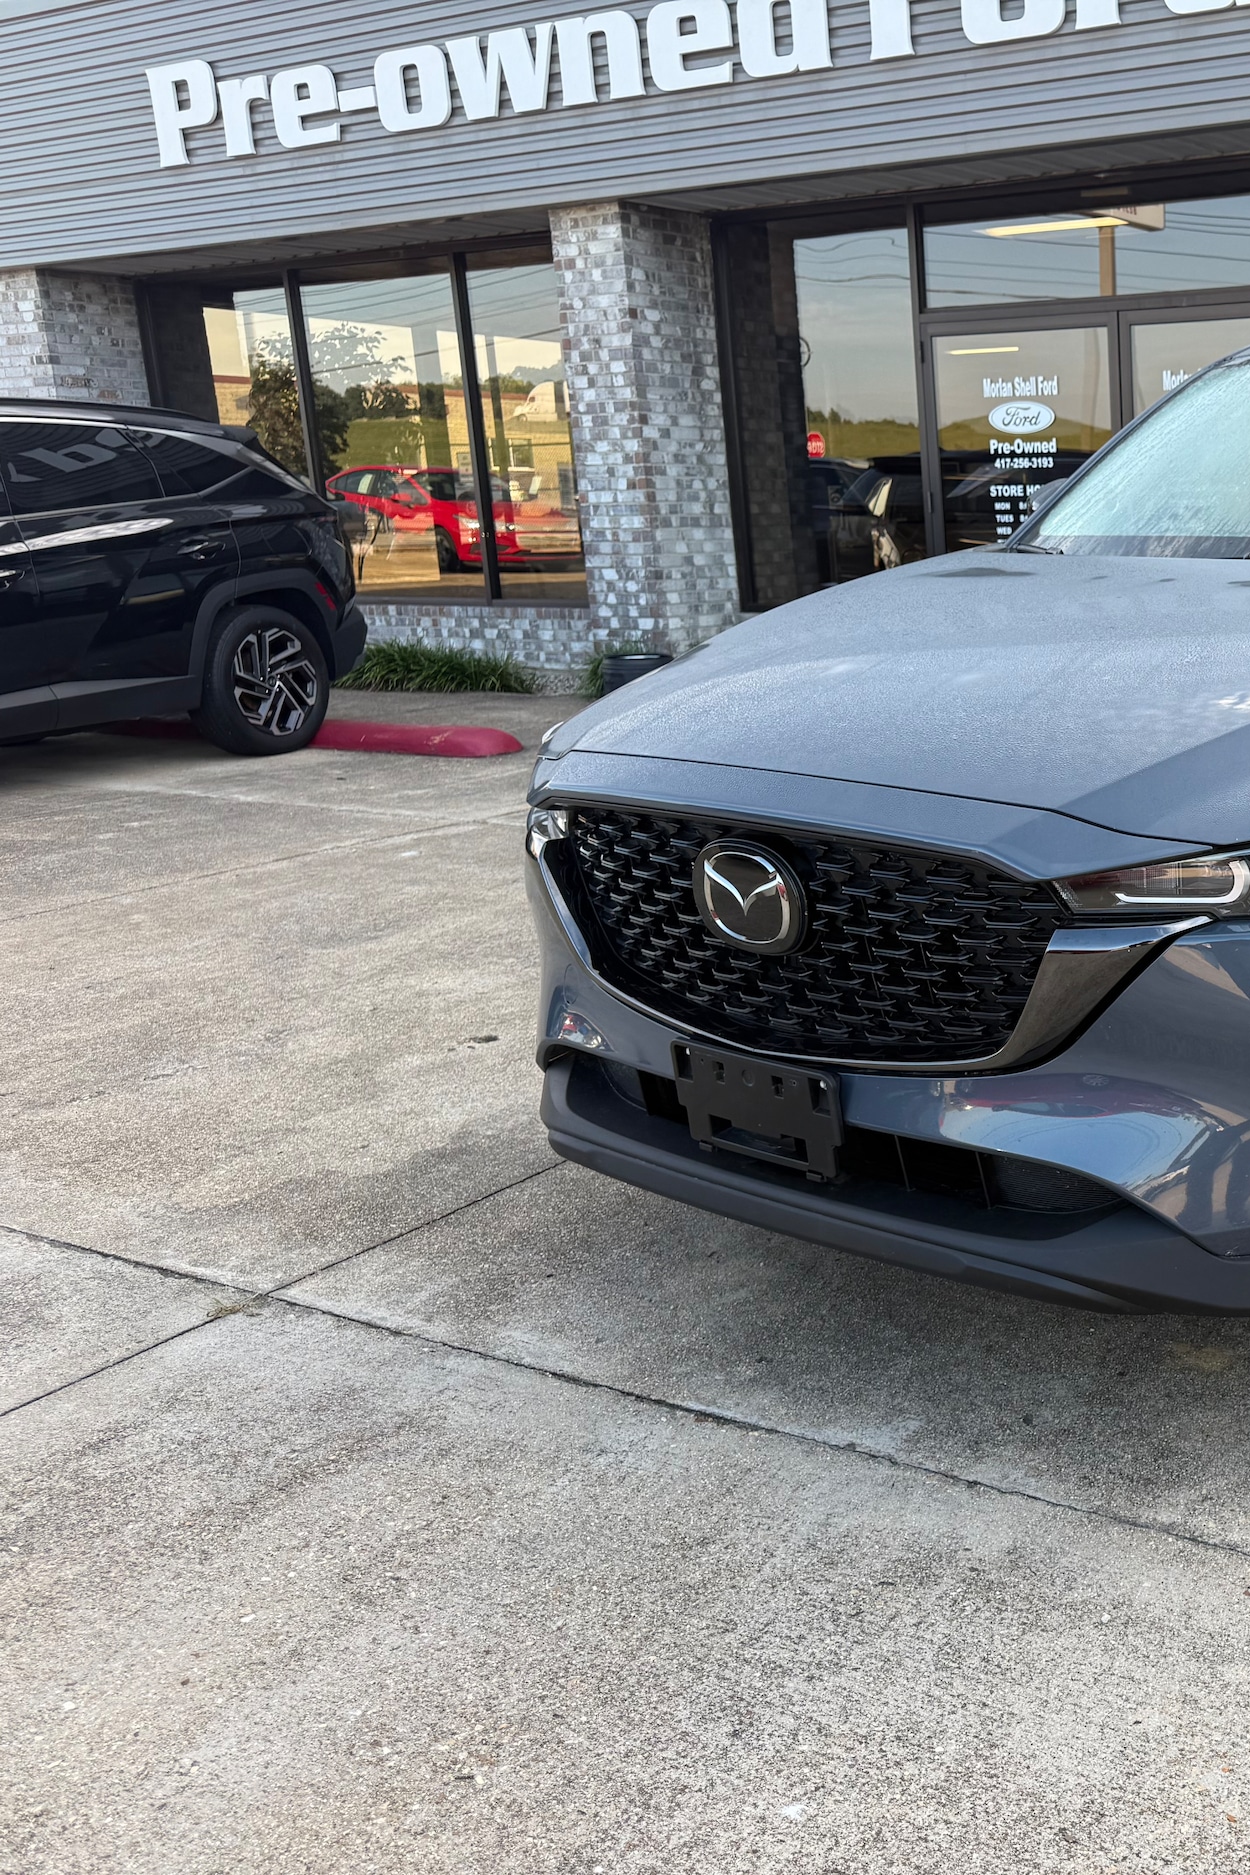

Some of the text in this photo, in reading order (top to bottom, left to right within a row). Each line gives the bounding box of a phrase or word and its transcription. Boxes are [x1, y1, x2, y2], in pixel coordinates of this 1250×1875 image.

[145, 0, 834, 167] Pre-owned
[983, 374, 1058, 398] Morlan Shell Ford
[1163, 369, 1192, 391] Morl
[1002, 406, 1041, 427] Ford
[989, 437, 1057, 455] Pre-Owned
[994, 456, 1054, 469] 417-256-3193
[989, 484, 1024, 498] STORE
[994, 502, 1011, 511] MON
[995, 513, 1015, 523] TUES
[996, 526, 1013, 536] WED
